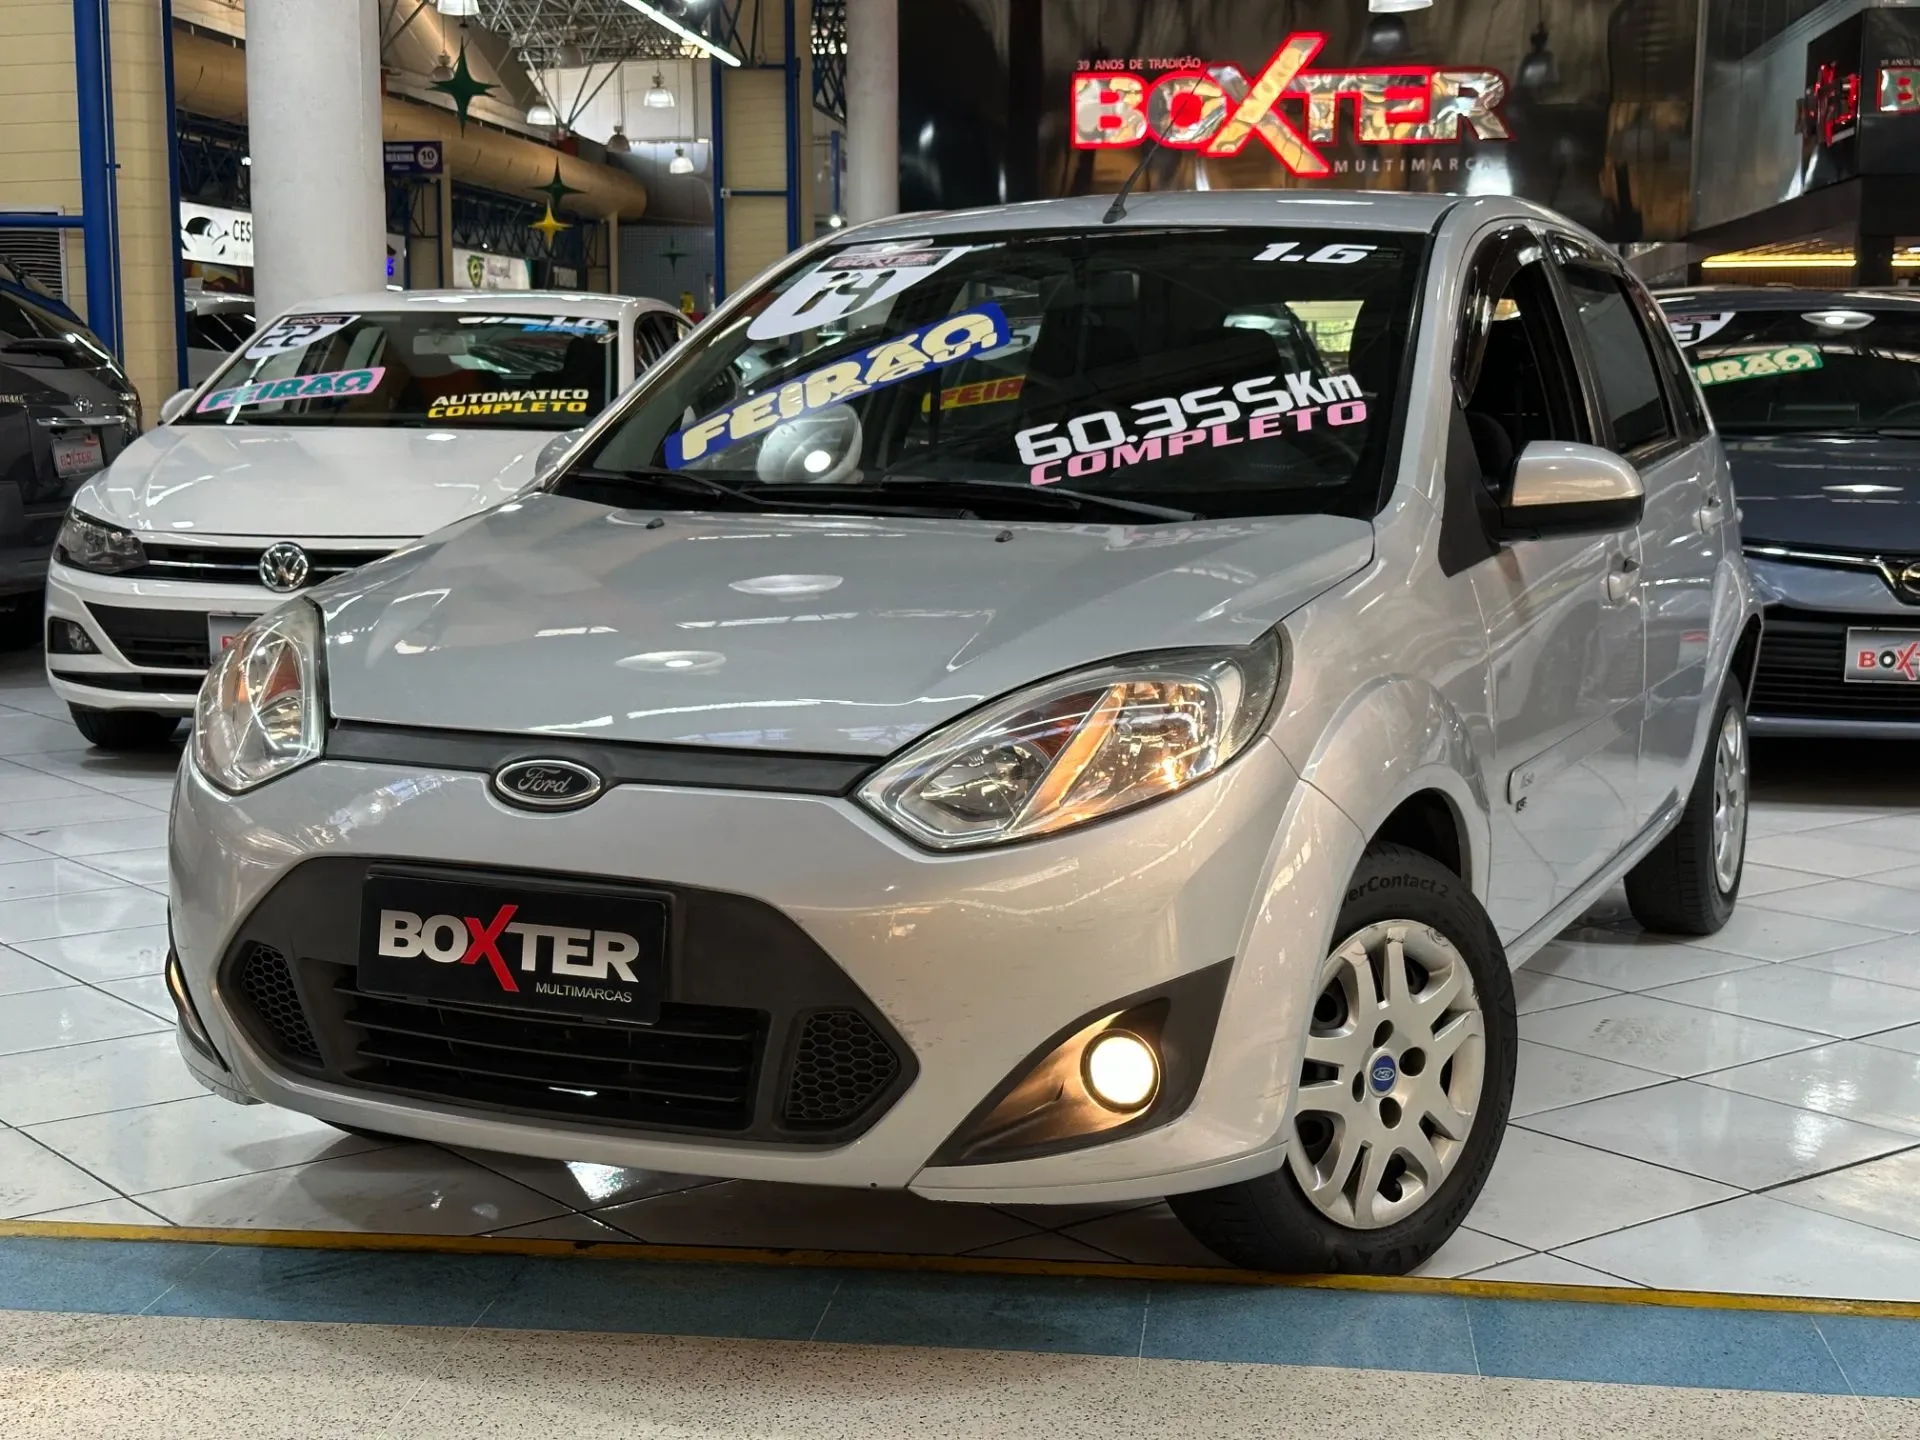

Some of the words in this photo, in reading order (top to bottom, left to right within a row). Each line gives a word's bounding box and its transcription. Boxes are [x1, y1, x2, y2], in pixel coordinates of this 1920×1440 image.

[1077, 60, 1090, 71] 39
[1095, 59, 1125, 70] ANOS
[1129, 58, 1143, 70] DE
[1149, 56, 1201, 71] TRADIÇÃO
[1072, 31, 1516, 178] BOXTER
[421, 150, 435, 161] 10
[1252, 241, 1378, 264] 1.6
[1691, 347, 1816, 385] IRÃO
[205, 370, 374, 410] FEIRÃO
[431, 388, 590, 408] AUTOMATICO
[682, 314, 998, 461] FEIRÃO
[427, 401, 588, 418] COMPLETO
[1014, 371, 1363, 466] 60.355Km
[1030, 400, 1367, 486] COMPLETO
[518, 766, 573, 793] Ford
[1344, 872, 1437, 904] erContact
[1438, 883, 1450, 898] 2
[378, 904, 640, 993] BOXTER
[535, 981, 633, 1003] MULTIMARCAS
